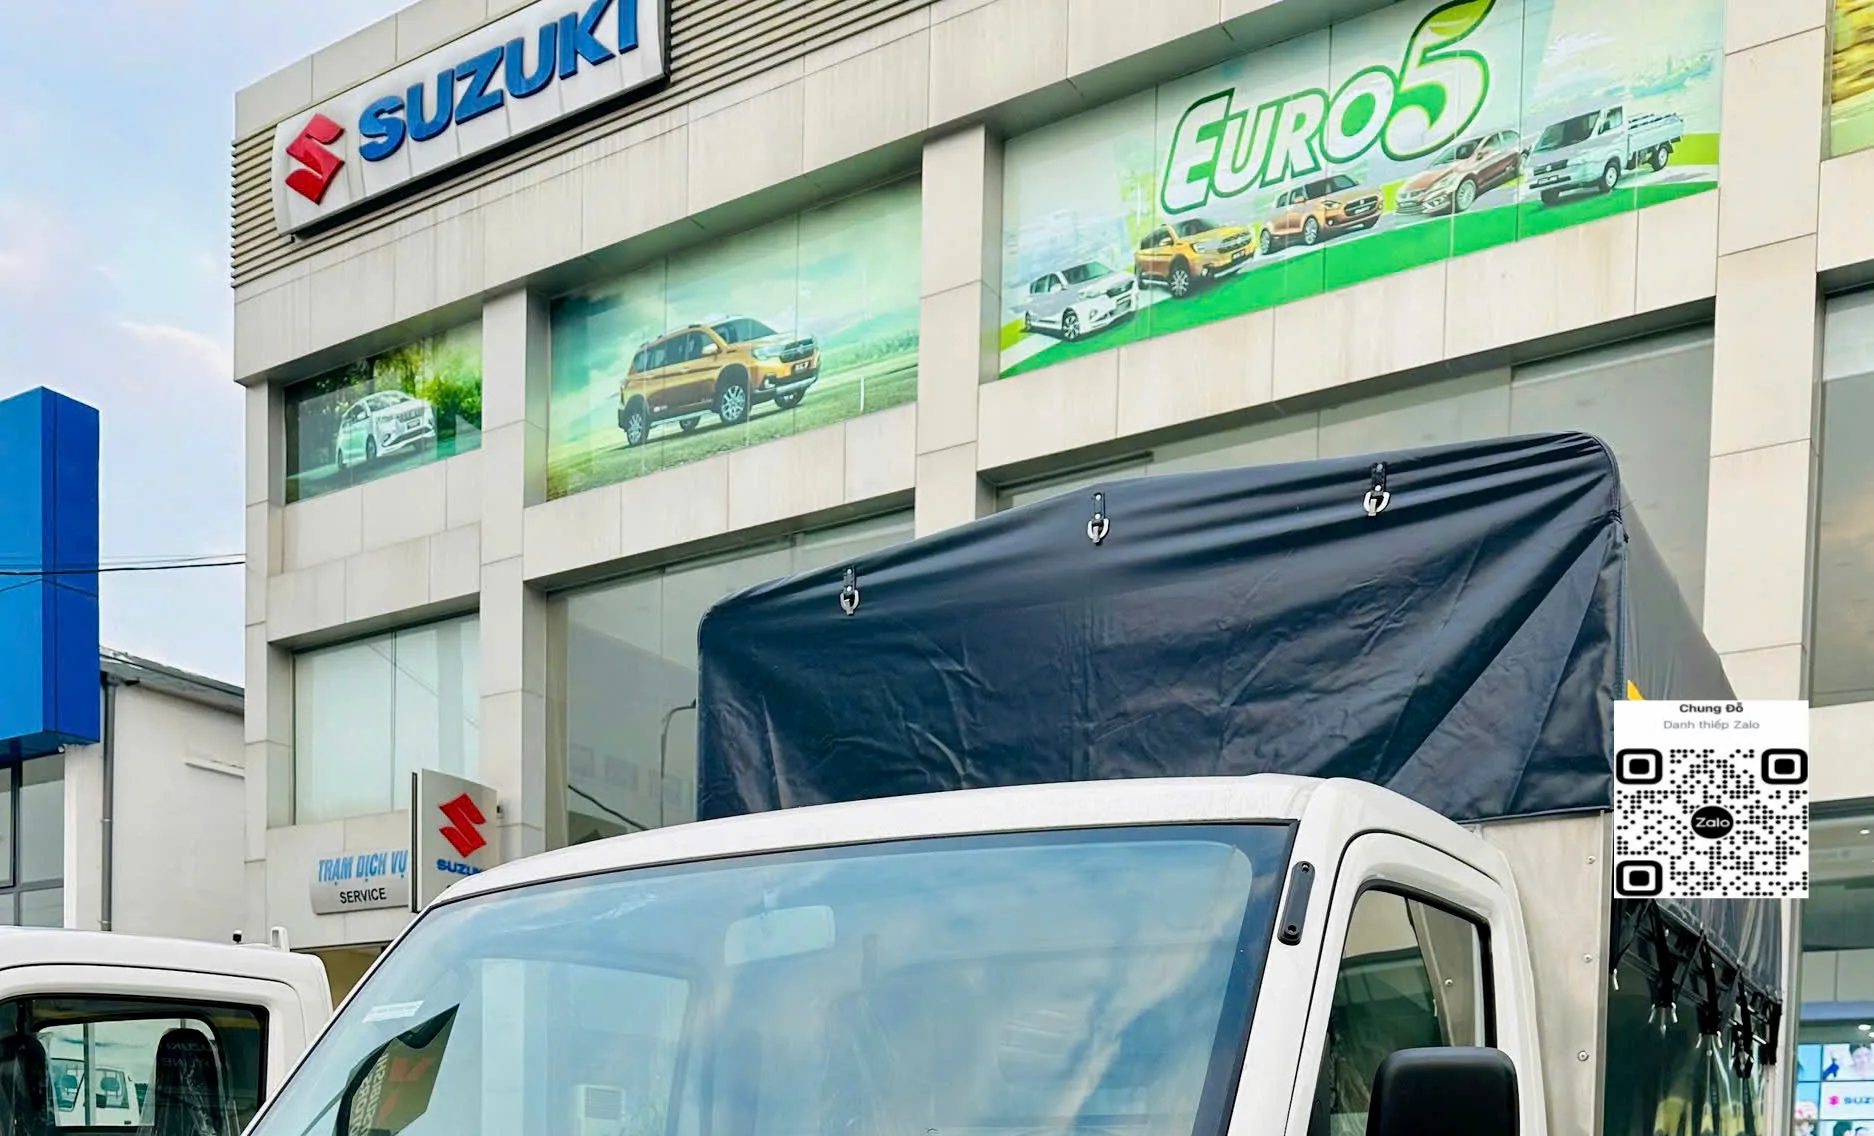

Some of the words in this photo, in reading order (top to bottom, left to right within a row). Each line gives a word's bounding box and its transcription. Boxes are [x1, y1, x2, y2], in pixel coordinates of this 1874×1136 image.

[358, 0, 639, 162] SUZUKI
[318, 856, 354, 886] TRẠM
[356, 852, 388, 882] DỊCH
[391, 849, 409, 879] VỤ
[339, 887, 388, 905] SERVICE
